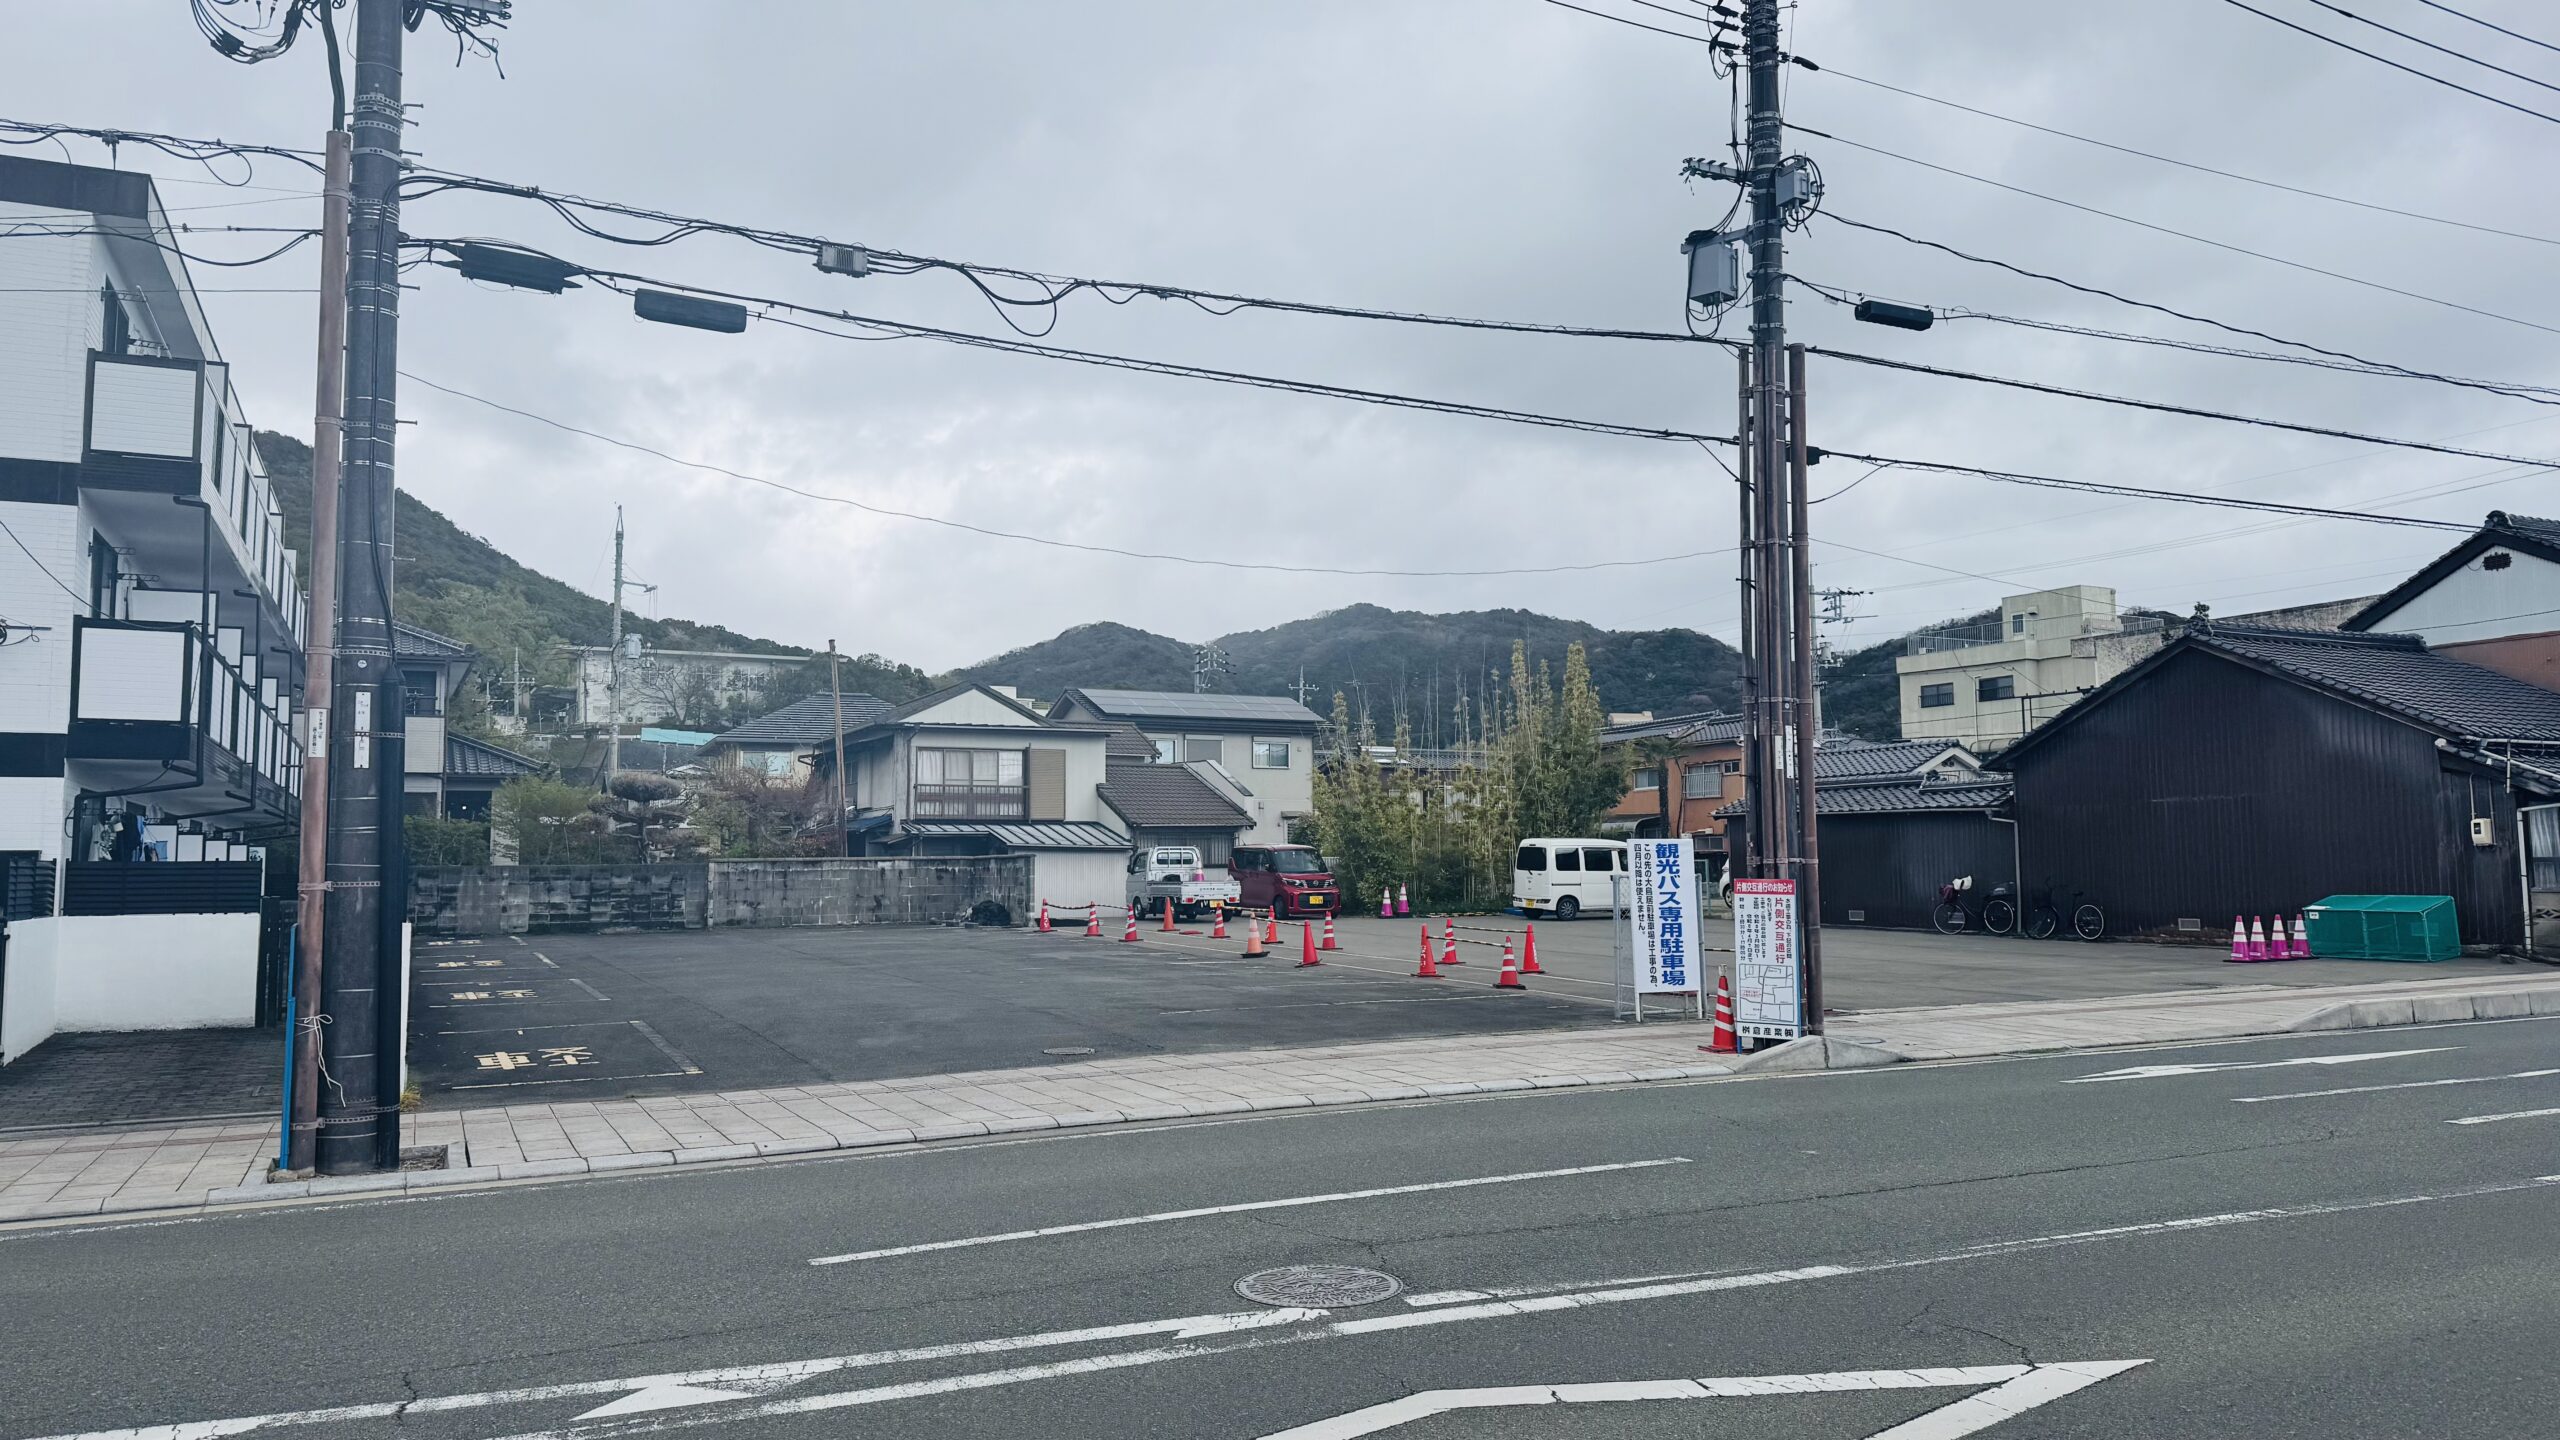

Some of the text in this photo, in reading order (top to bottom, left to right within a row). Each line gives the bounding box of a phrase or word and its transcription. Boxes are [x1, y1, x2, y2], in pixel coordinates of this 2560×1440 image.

[1736, 881, 1793, 893] 片側交互通行のお知らせ
[1655, 843, 1686, 986] 観光バス専用駐車場
[1774, 897, 1786, 964] 片側交互通行
[473, 1046, 601, 1070] 軽
